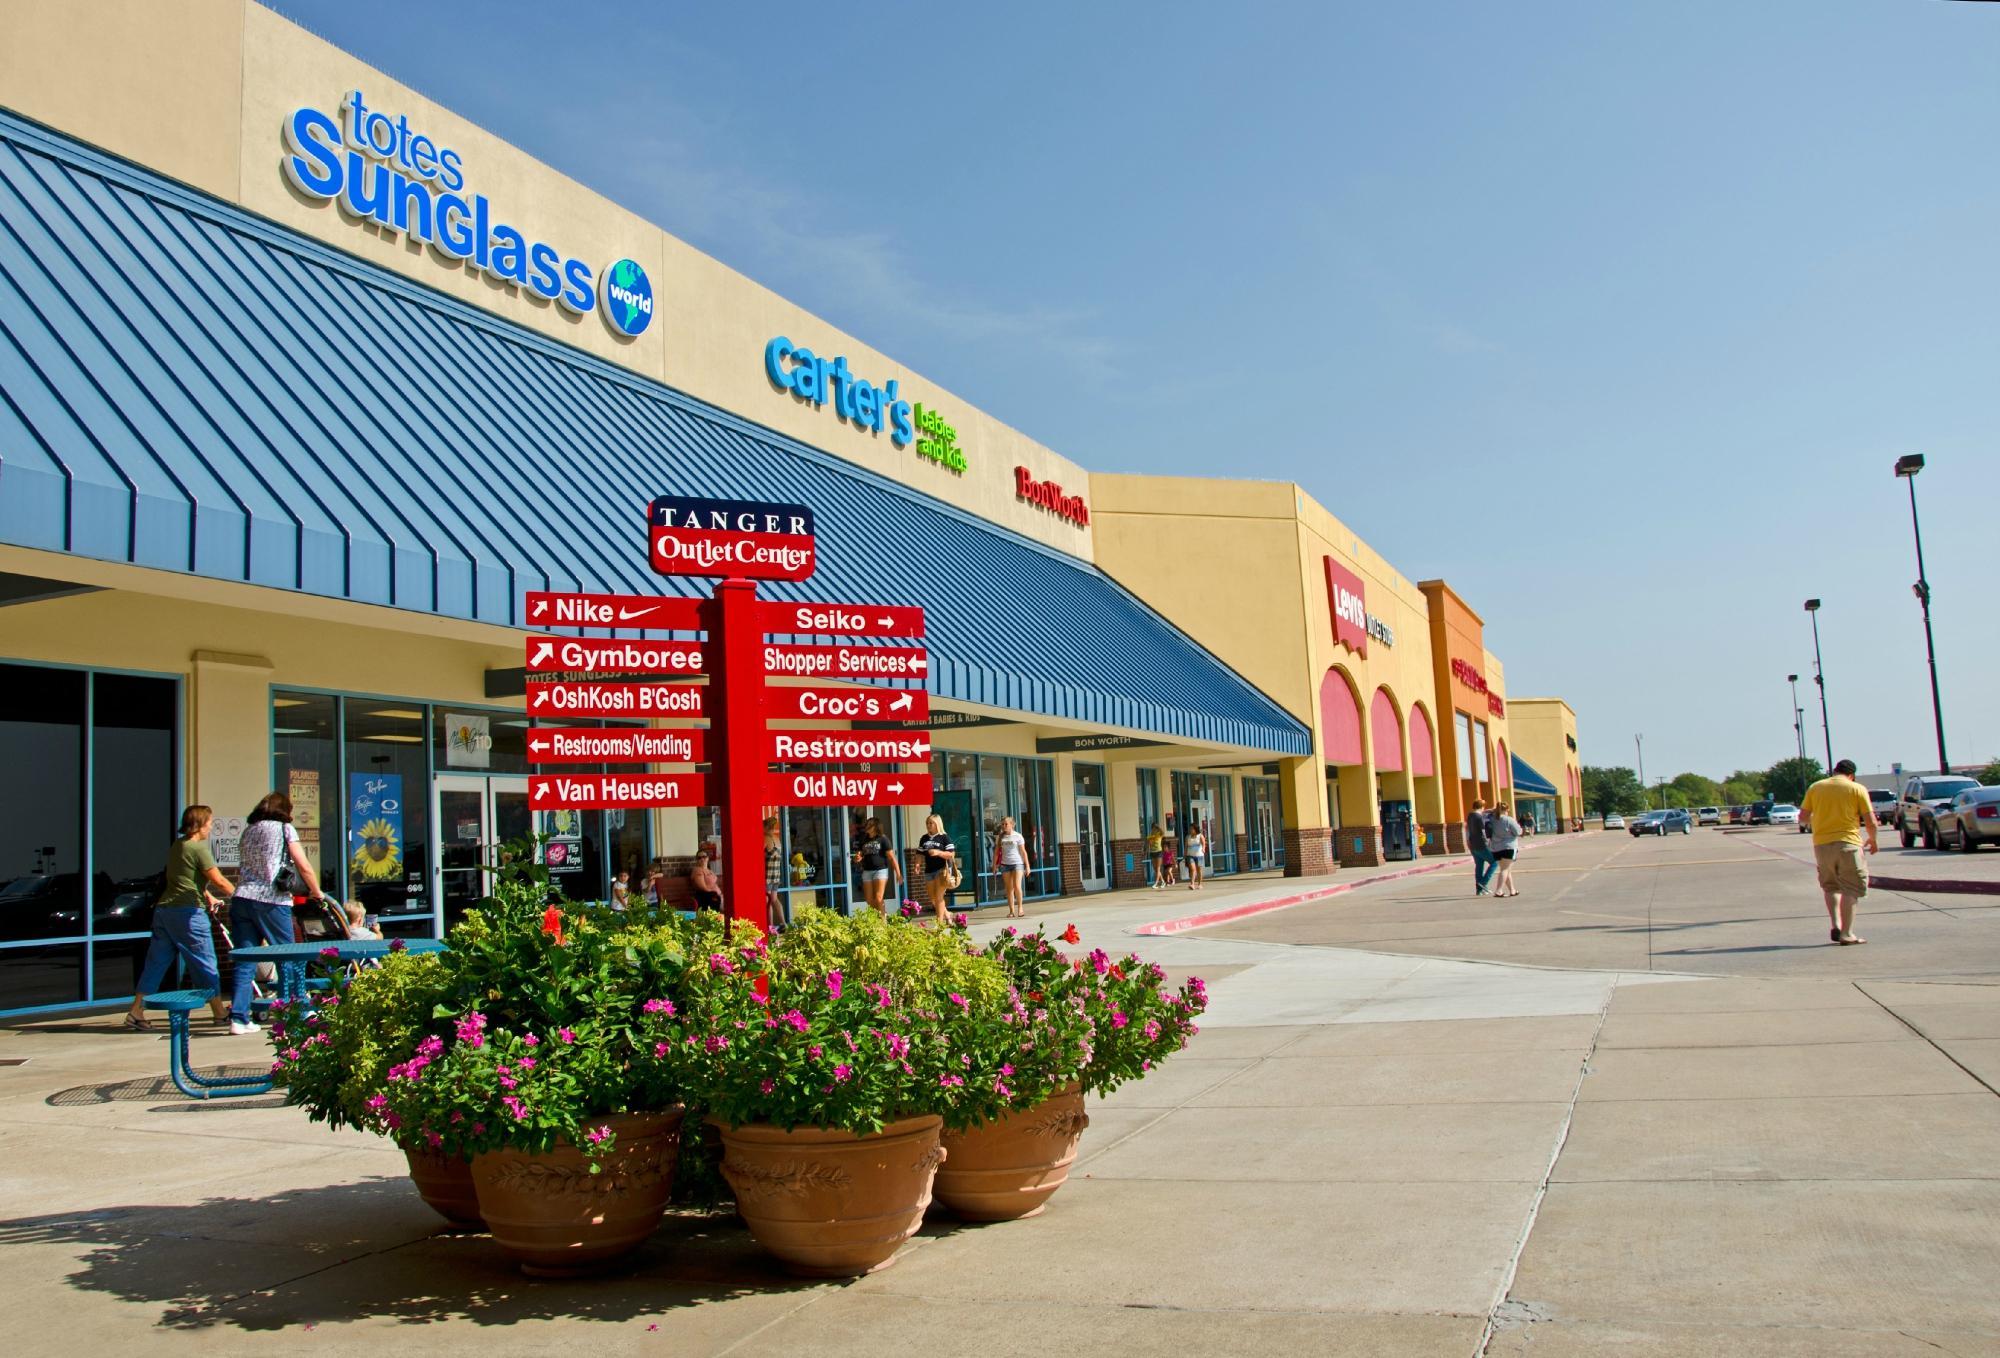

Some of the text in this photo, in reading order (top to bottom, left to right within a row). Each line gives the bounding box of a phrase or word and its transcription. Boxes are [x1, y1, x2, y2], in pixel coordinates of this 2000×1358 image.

[343, 88, 465, 192] totes
[610, 283, 652, 313] world
[765, 335, 913, 445] carter's
[914, 402, 957, 442] babies
[916, 439, 968, 473] and kids
[660, 508, 808, 535] TANGER
[657, 535, 811, 571] Outlet Center
[556, 599, 614, 622] Nike
[796, 608, 866, 630] Seiko
[561, 642, 703, 671] Gymboree
[764, 648, 906, 675] Shopper Services
[552, 686, 701, 711] OshKosh B'Gosh
[799, 692, 880, 715] Croc's
[933, 714, 956, 724] BABIES
[554, 734, 692, 760] Restrooms/Vending
[775, 736, 911, 758] Restrooms
[1074, 737, 1131, 747] BON WORTH
[860, 762, 871, 772] 109
[556, 778, 678, 801] Van Heusen
[793, 776, 878, 800] Old Navy
